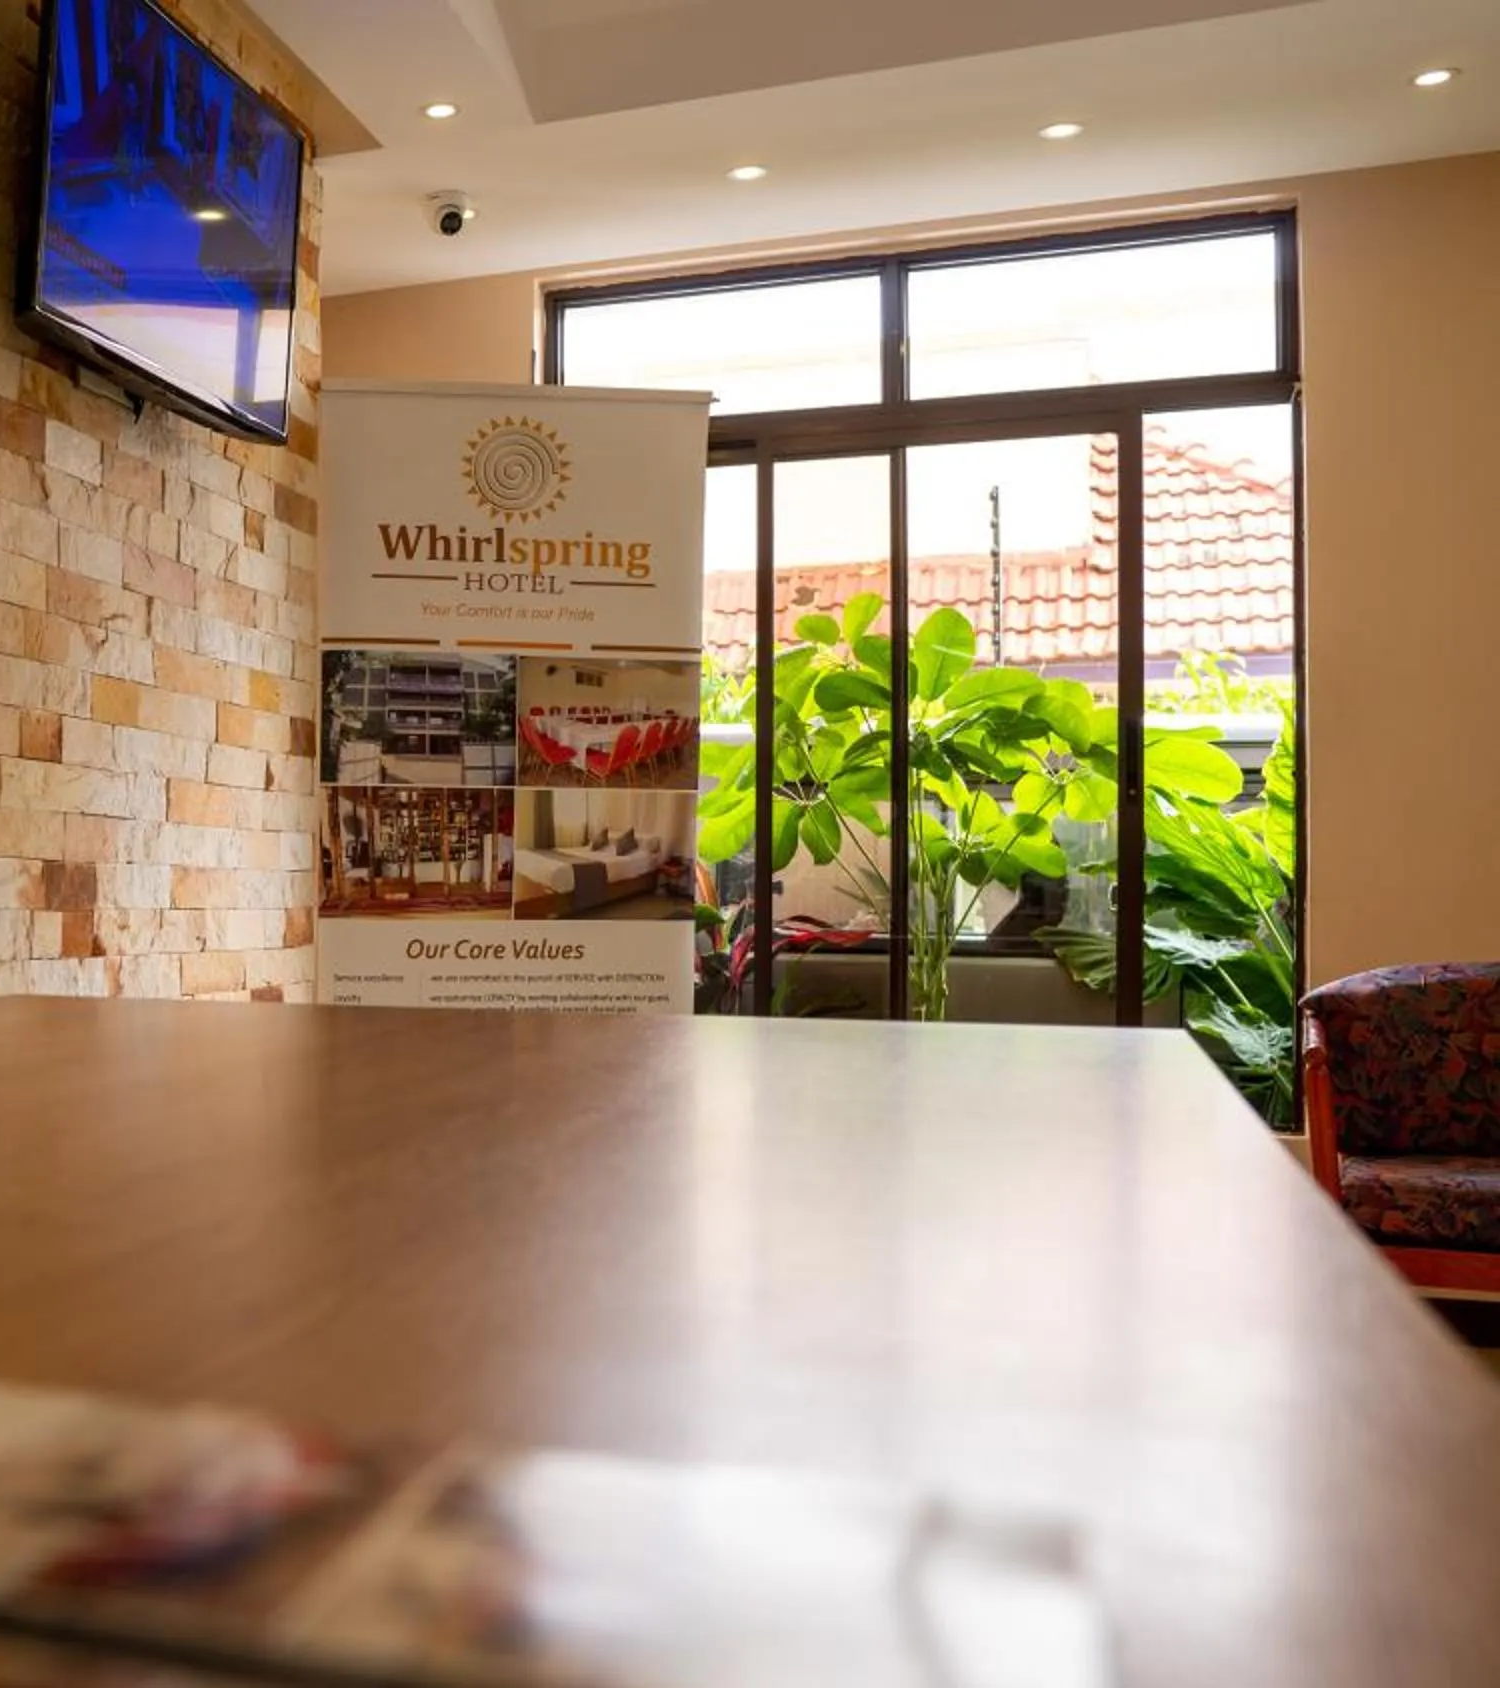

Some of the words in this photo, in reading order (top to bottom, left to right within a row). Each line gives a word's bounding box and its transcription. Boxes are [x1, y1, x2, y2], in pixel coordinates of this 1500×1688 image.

[377, 523, 652, 580] Whirlspring
[463, 571, 565, 596] HOTEL
[420, 602, 452, 617] Your
[455, 602, 513, 619] Comfort
[516, 606, 527, 619] is
[531, 608, 553, 620] our
[557, 606, 595, 622] Pride
[406, 939, 449, 960] Our
[454, 939, 505, 960] Core
[512, 938, 585, 961] Values
